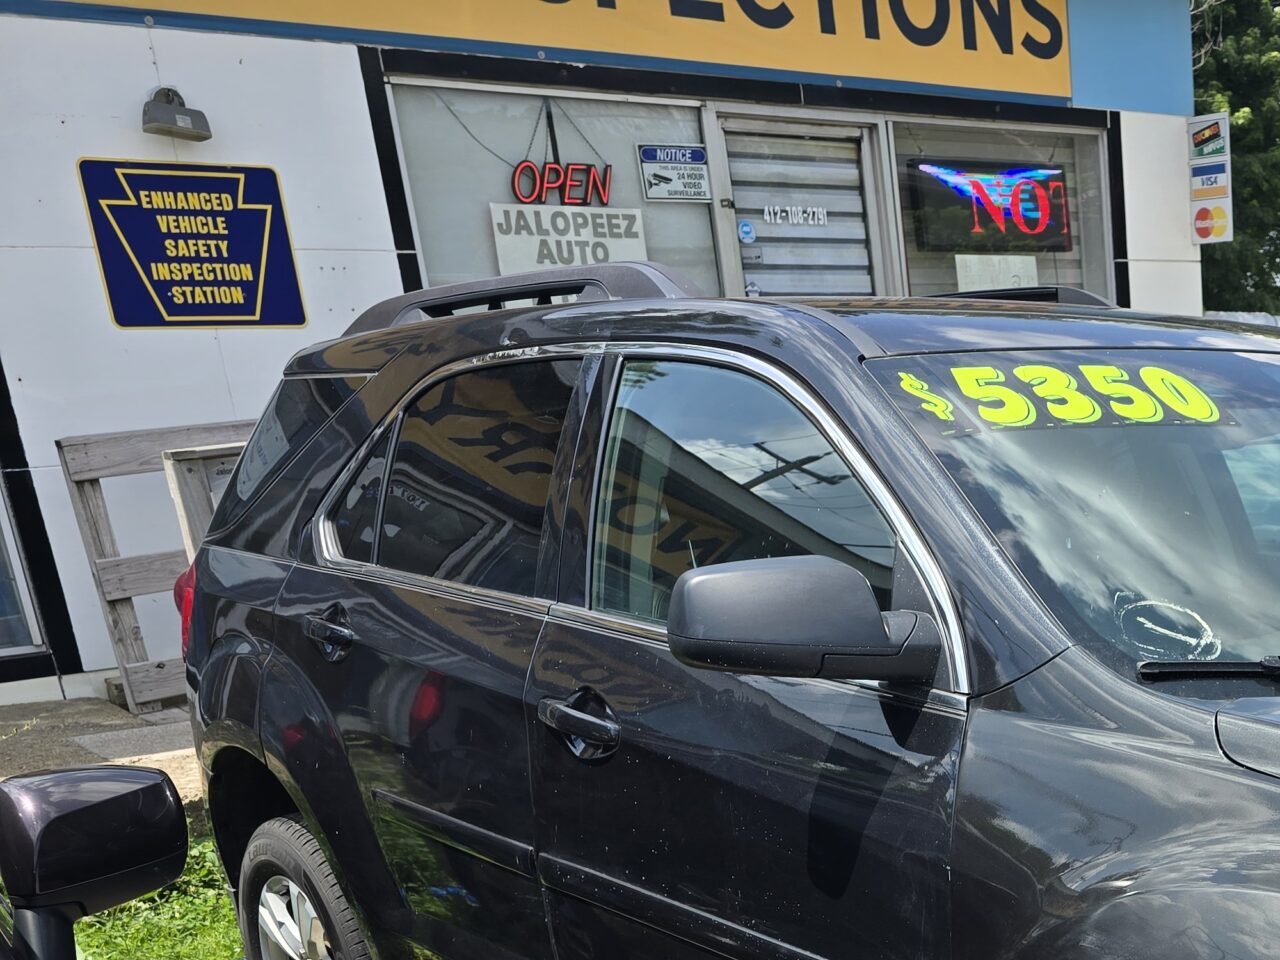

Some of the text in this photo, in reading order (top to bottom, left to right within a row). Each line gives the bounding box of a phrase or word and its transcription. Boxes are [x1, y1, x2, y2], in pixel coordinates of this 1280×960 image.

[656, 149, 692, 162] NOTICE
[512, 160, 612, 205] OPEN
[676, 172, 705, 181] 24 HOUR
[682, 182, 703, 190] VIDEO
[1201, 176, 1218, 187] VISA
[139, 190, 234, 211] ENHANCED
[667, 189, 707, 197] SURVEILLANCE
[156, 214, 229, 235] VEHICLE
[496, 209, 640, 239] JALOPEEZ
[763, 204, 828, 225] 412-708-2791
[164, 238, 228, 258] SAFETY
[535, 238, 610, 265] AUTO
[150, 262, 254, 281] INSPECTION
[171, 286, 245, 304] STATION
[897, 364, 1221, 427] $5350
